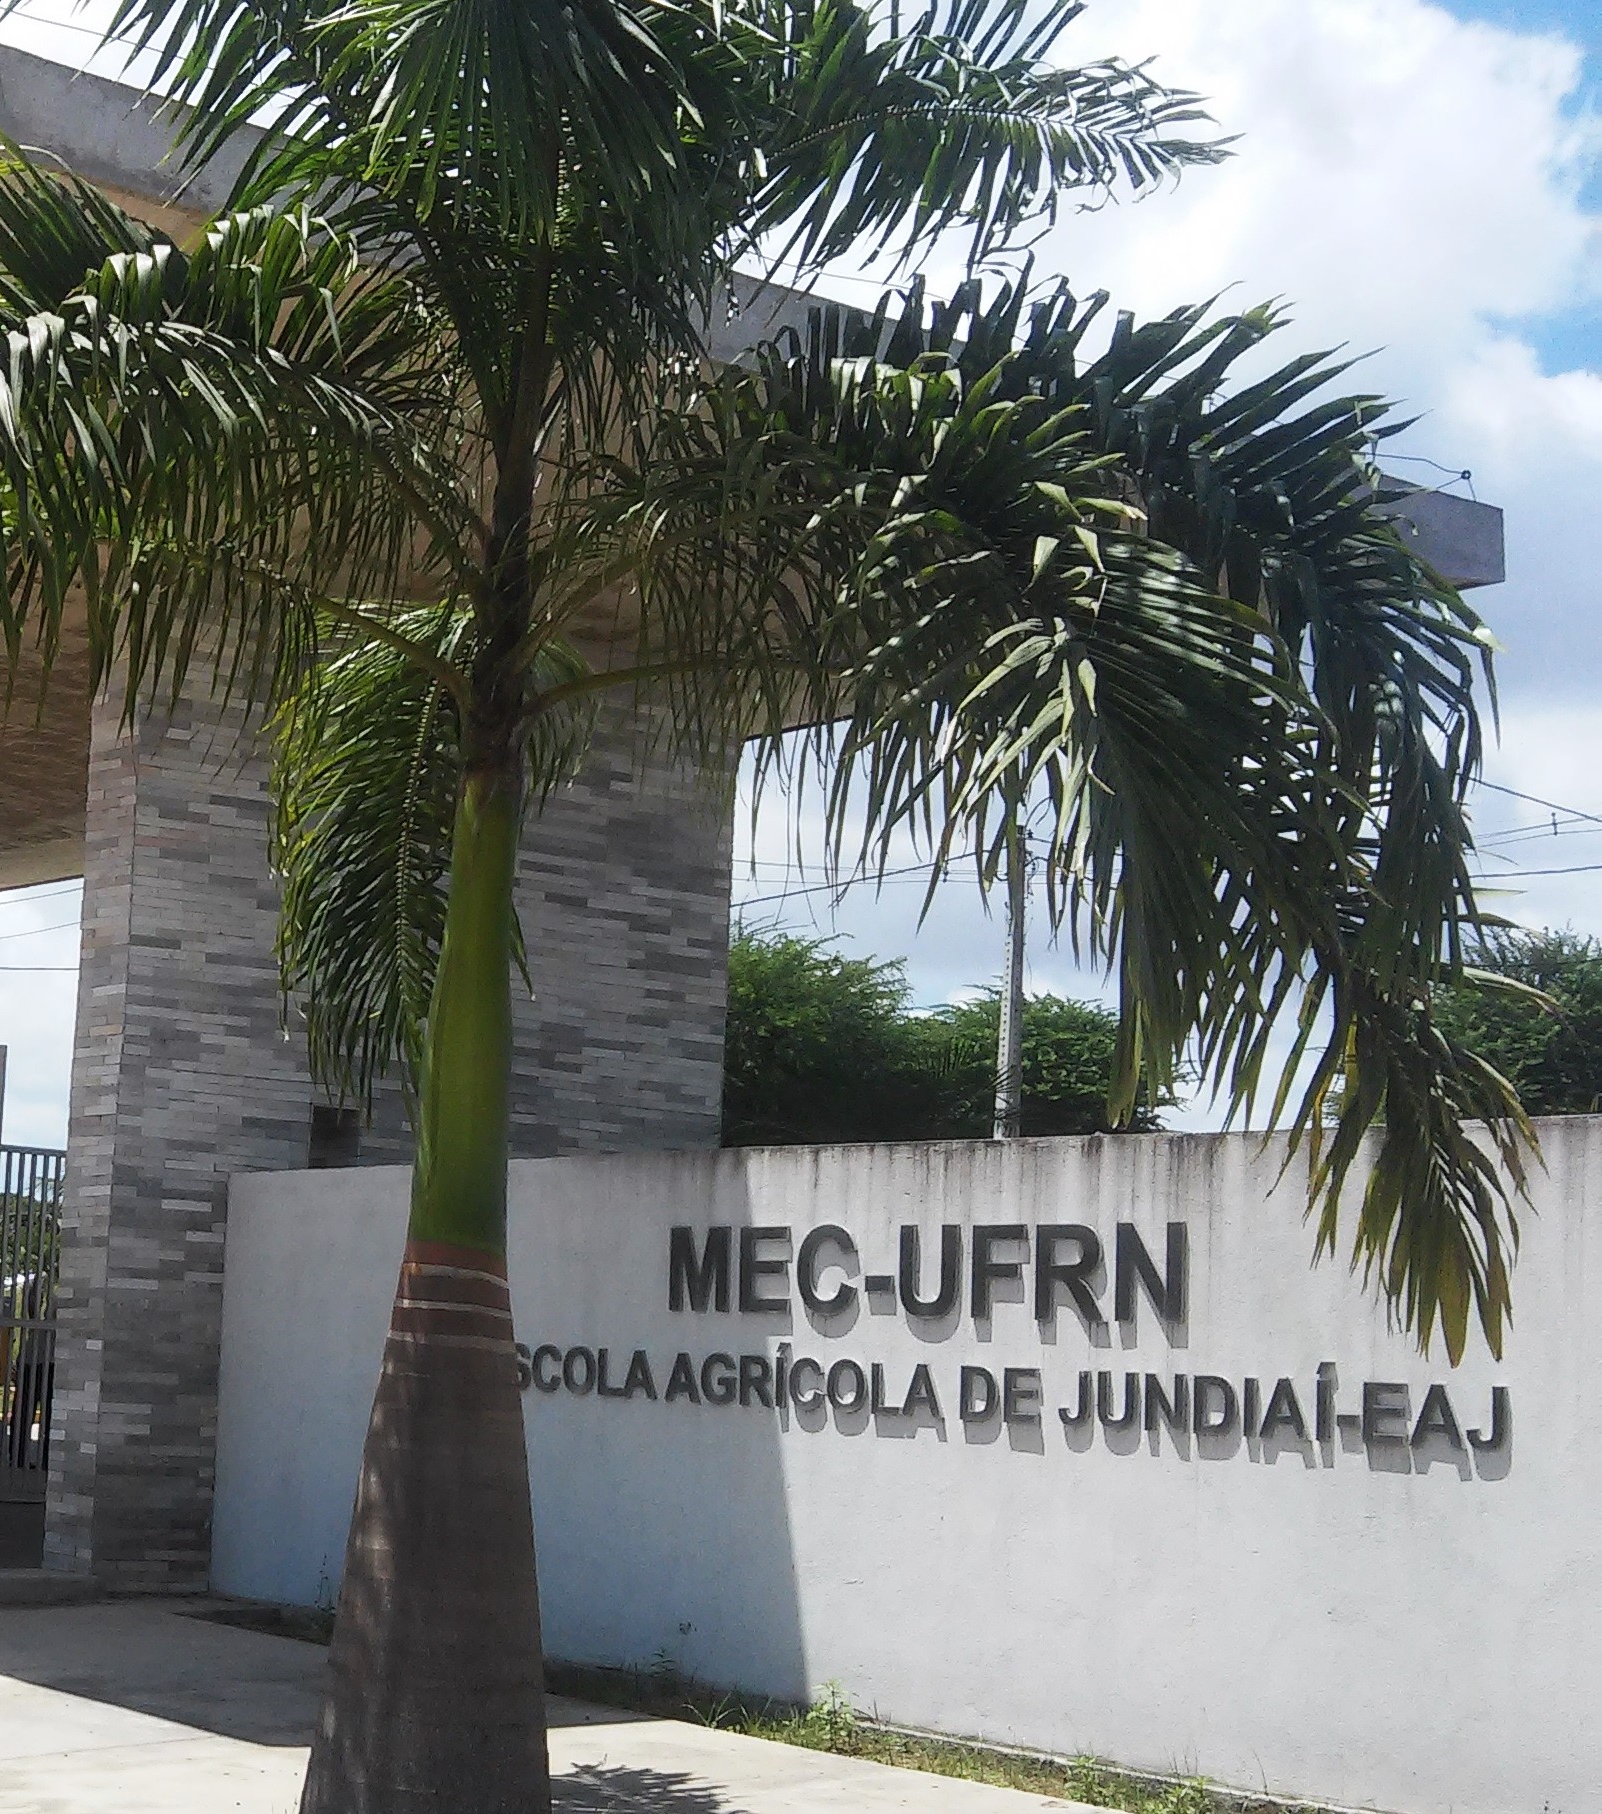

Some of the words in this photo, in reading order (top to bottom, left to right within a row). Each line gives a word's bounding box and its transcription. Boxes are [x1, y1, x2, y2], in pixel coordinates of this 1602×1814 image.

[668, 1222, 1187, 1322] MEC-UFRN
[514, 1342, 658, 1401] SCOLA
[664, 1342, 944, 1417] AGRÍCOLA
[960, 1365, 1042, 1424] DE
[1058, 1361, 1511, 1448] JUNDIAÍ-EAJ
